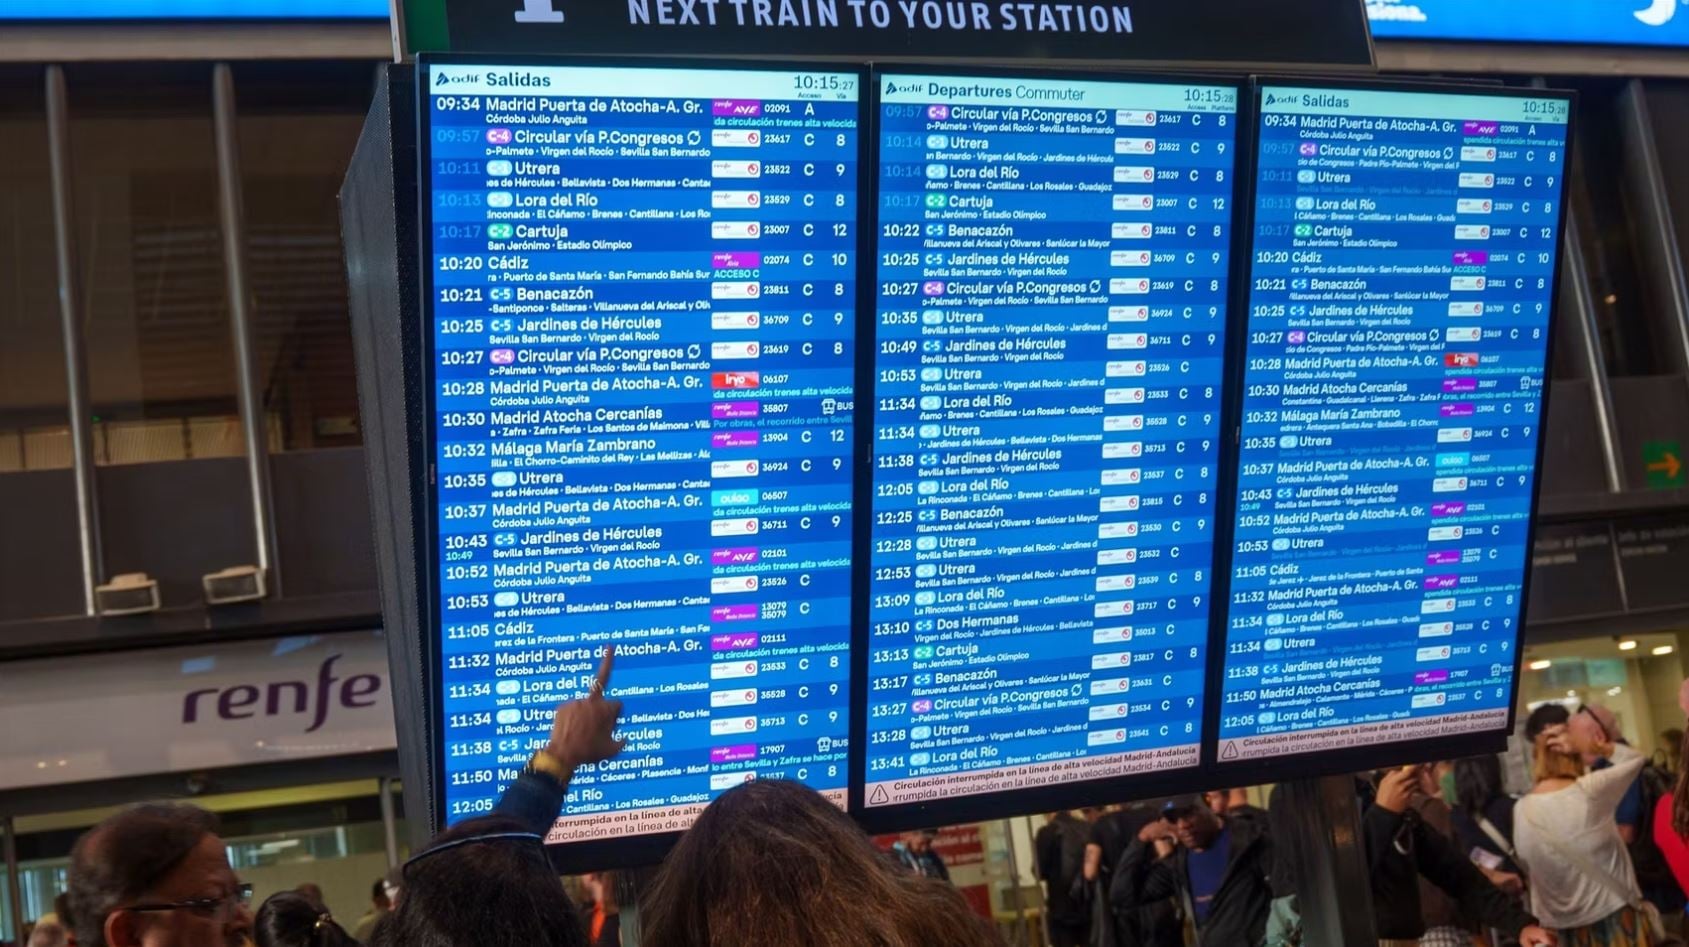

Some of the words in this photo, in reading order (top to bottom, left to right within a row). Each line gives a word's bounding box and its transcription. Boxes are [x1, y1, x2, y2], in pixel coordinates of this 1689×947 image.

[628, 0, 717, 25] NEXT
[730, 0, 838, 28] TRAIN
[848, 0, 890, 28] TO
[901, 2, 991, 30] YOUR
[1000, 4, 1134, 34] STATION
[451, 73, 480, 84] adif
[487, 73, 550, 87] Salidas
[899, 85, 922, 93] adif
[929, 84, 1012, 99] Departures
[1016, 86, 1085, 100] Commuter
[437, 97, 480, 110] 09:34
[487, 98, 535, 111] Madrid
[540, 98, 586, 111] Puerta
[589, 99, 607, 112] de
[610, 99, 679, 113] Atocha-A.
[683, 100, 703, 113] Gr.
[765, 104, 790, 113] 02091
[805, 103, 814, 115] A
[1302, 95, 1349, 107] Salidas
[486, 114, 526, 123] Córdoba
[528, 114, 551, 123] Julio
[552, 115, 587, 126] Anguita
[929, 108, 947, 117] C-4
[951, 107, 999, 119] Circular
[1002, 108, 1019, 120] vía
[1022, 109, 1092, 126] P.Congresos
[1192, 114, 1200, 125] C
[1219, 115, 1226, 126] 8
[1265, 115, 1296, 126] 09:34
[1301, 116, 1337, 128] Madrid
[1339, 117, 1373, 129] Puerta
[1375, 119, 1388, 130] de
[1390, 120, 1440, 131] Atocha-A.
[1442, 121, 1456, 132] Gr.
[1528, 125, 1535, 135] A
[490, 132, 509, 141] C-4
[515, 130, 571, 143] Circular
[575, 130, 595, 143] vía
[599, 132, 683, 146] P.Congresos
[804, 133, 814, 146] C
[837, 134, 845, 146] 8
[515, 162, 560, 175] Utrera
[804, 164, 814, 176] C
[836, 164, 845, 176] 9
[950, 166, 976, 178] Lora
[979, 166, 998, 178] del
[1001, 166, 1019, 178] Río
[926, 196, 944, 206] C-2
[949, 195, 993, 212] Cartuja
[1213, 198, 1224, 209] 12
[490, 228, 510, 236] C-2
[516, 224, 568, 241] Cartuja
[764, 225, 789, 234] 23007
[804, 224, 813, 236] C
[833, 224, 846, 236] 12
[884, 224, 919, 236] 10:22
[926, 226, 943, 235] C-5
[949, 224, 1013, 236] Benacazón
[488, 241, 505, 250] San
[507, 241, 550, 250] Jerónimo
[557, 241, 590, 250] Estadio
[592, 240, 632, 251] Olímpico
[440, 257, 482, 270] 10:20
[488, 256, 528, 269] Cádiz
[764, 256, 789, 264] 02074
[803, 253, 813, 266] C
[832, 253, 847, 265] 10
[883, 253, 919, 265] 10:25
[926, 255, 943, 264] C-5
[948, 253, 998, 265] Jardines
[1001, 253, 1016, 264] de
[1019, 252, 1069, 264] Hércules
[1257, 252, 1288, 262] 10:20
[1292, 251, 1321, 263] Cádiz
[504, 272, 534, 281] Puerto
[536, 272, 548, 281] de
[549, 272, 575, 280] Santa
[577, 271, 602, 280] María
[608, 271, 625, 280] San
[627, 271, 668, 279] Fernando
[670, 270, 694, 279] Bahía
[714, 270, 750, 278] ACCESO
[1255, 279, 1286, 290] 10:21
[1311, 278, 1366, 289] Benacazón
[441, 288, 483, 302] 10:21
[490, 290, 510, 299] C-5
[517, 286, 593, 300] Benacazón
[442, 320, 483, 333] 10:25
[491, 321, 511, 330] C-5
[518, 318, 577, 331] Jardines
[581, 317, 598, 330] de
[602, 316, 661, 329] Hércules
[443, 382, 484, 395] 10:28
[726, 375, 745, 386] iryo
[763, 375, 788, 383] 06107
[1248, 385, 1279, 396] 10:30
[1283, 384, 1319, 395] Madrid
[1321, 383, 1357, 394] Atocha
[1359, 381, 1407, 393] Cercanías
[443, 413, 485, 426] 10:30
[491, 410, 539, 424] Madrid
[543, 409, 592, 423] Atocha
[595, 406, 662, 421] Cercanías
[837, 402, 854, 410] BUS
[1247, 411, 1277, 423] 10:32
[1282, 410, 1319, 423] Málaga
[1321, 409, 1349, 420] María
[1351, 408, 1400, 419] Zambrano
[444, 444, 485, 457] 10:32
[492, 441, 542, 457] Málaga
[546, 439, 583, 453] María
[588, 438, 656, 452] Zambrano
[801, 431, 811, 442] C
[831, 429, 844, 441] 12
[879, 455, 913, 468] 11:38
[920, 455, 937, 465] C-5
[942, 452, 992, 464] Jardines
[995, 450, 1009, 462] de
[1012, 448, 1061, 461] Hércules
[878, 511, 912, 524] 12:25
[941, 505, 1003, 520] Benacazón
[449, 624, 489, 639] 11:05
[495, 622, 534, 635] Cádiz
[875, 622, 909, 635] 13:10
[915, 622, 931, 630] C-5
[937, 619, 959, 630] Dos
[962, 615, 1018, 627] Hermanas
[1228, 666, 1258, 678] 11:38
[1282, 661, 1324, 673] Jardines
[1325, 659, 1338, 668] de
[1340, 655, 1382, 667] Hércules
[182, 654, 381, 733] renfe
[1225, 715, 1254, 727] 12:05
[1277, 712, 1299, 722] Lora
[1301, 708, 1316, 719] del
[1319, 706, 1334, 717] Río
[871, 756, 904, 770] 13:41
[894, 778, 946, 790] Circulación
[948, 771, 1004, 785] interrumpida
[1007, 769, 1017, 777] en
[1029, 765, 1050, 774] línea
[1064, 762, 1080, 770] alta
[1083, 756, 1122, 767] velocidad
[1124, 747, 1196, 762] Madrid-Andalucía
[453, 799, 493, 813] 12:05
